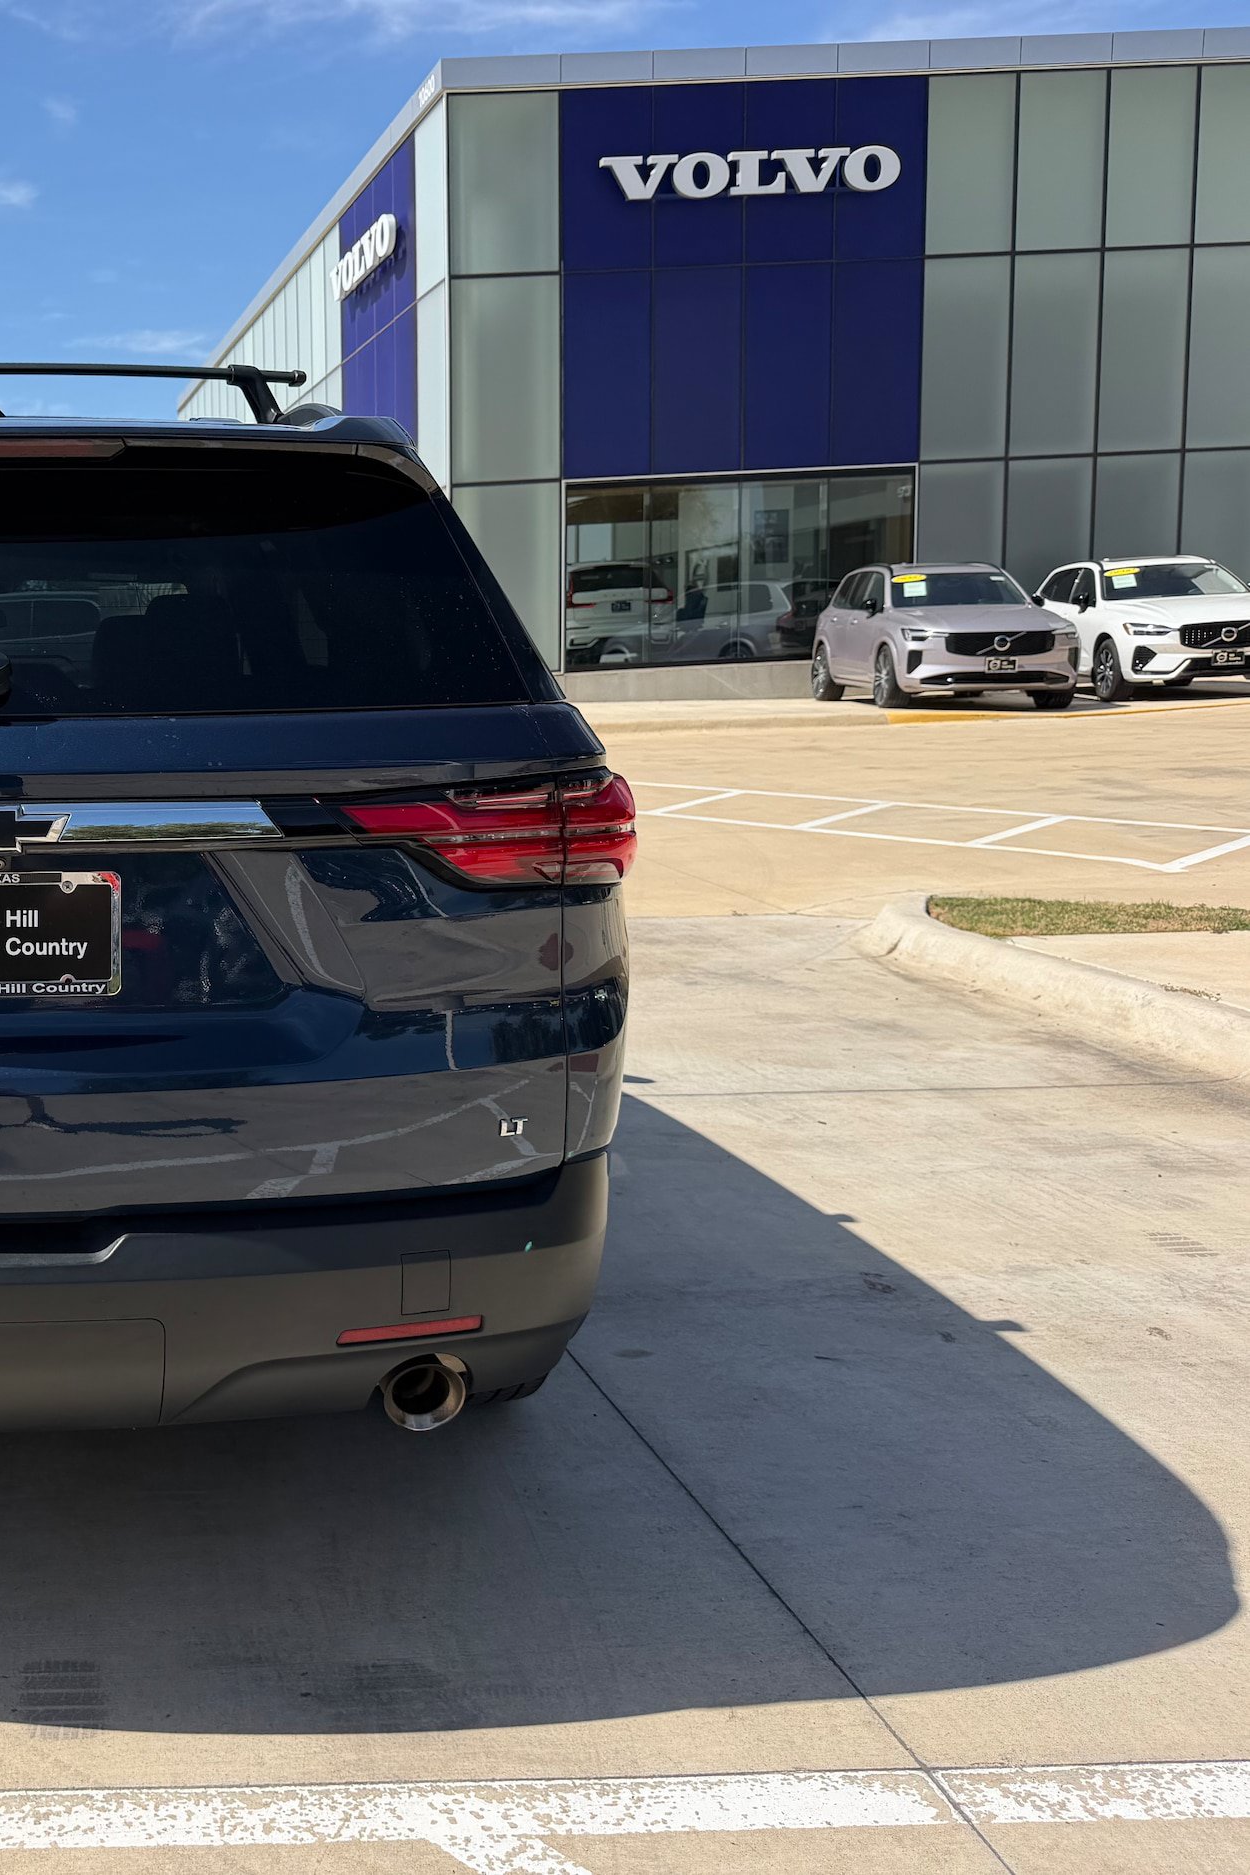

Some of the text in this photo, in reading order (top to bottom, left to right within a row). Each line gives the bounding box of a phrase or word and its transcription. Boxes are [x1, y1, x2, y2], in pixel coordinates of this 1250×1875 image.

[599, 144, 901, 200] VOLVO
[330, 213, 396, 302] VOLVO
[6, 910, 38, 928] Hill
[5, 937, 88, 959] Country
[32, 982, 106, 995] Country
[500, 1118, 528, 1137] LT
